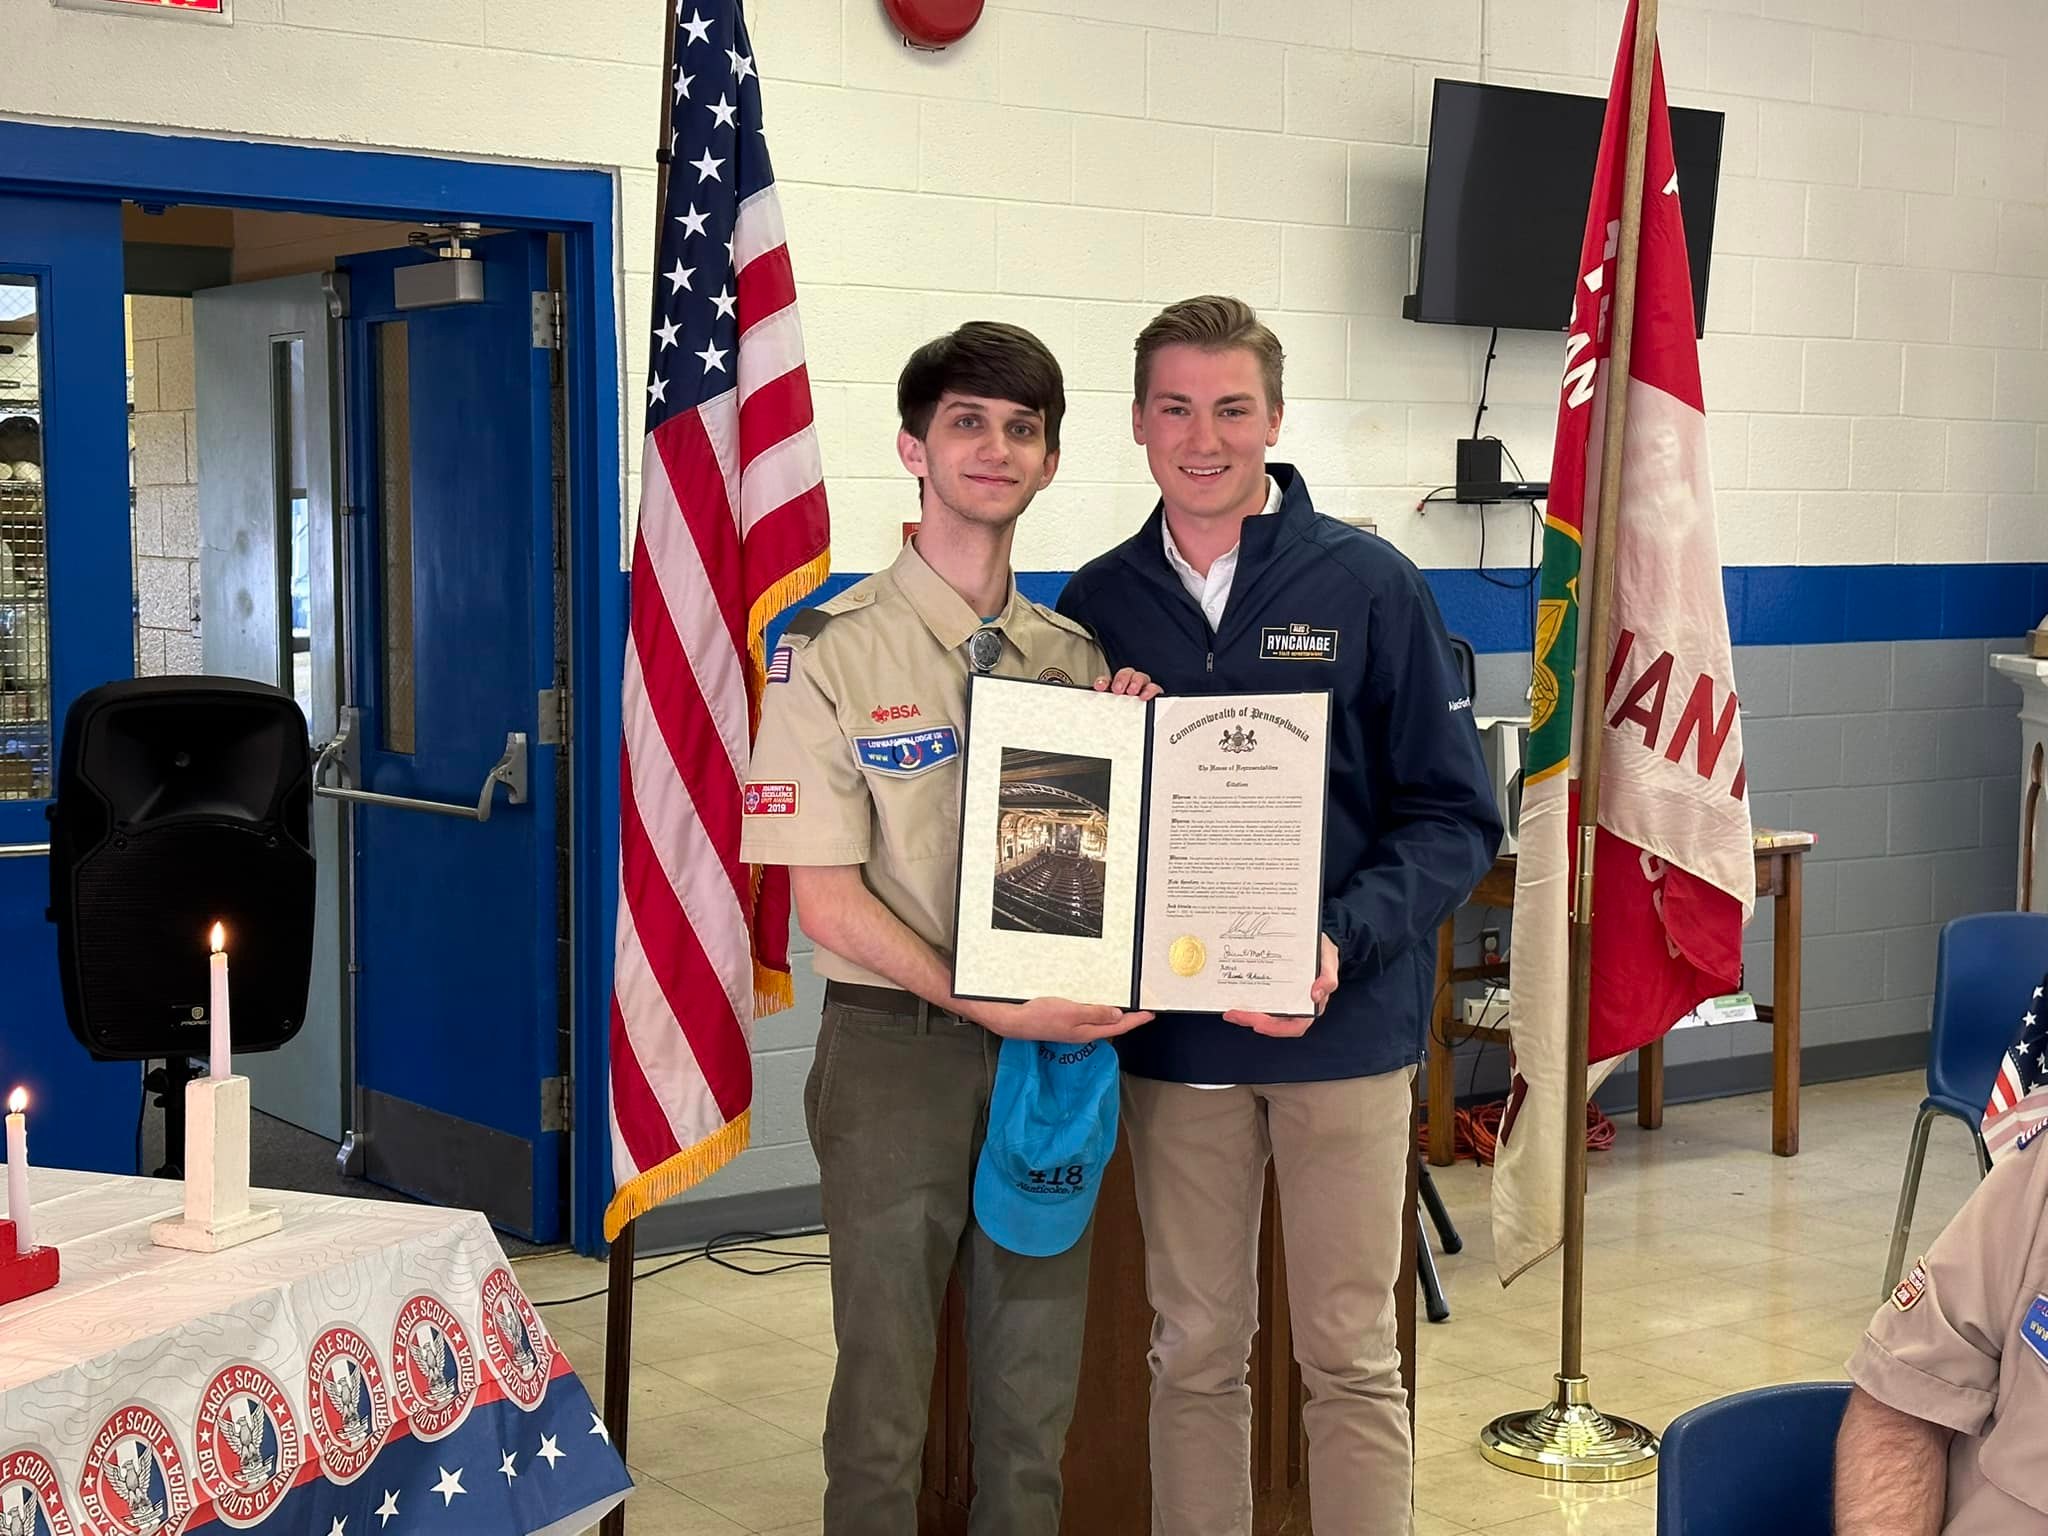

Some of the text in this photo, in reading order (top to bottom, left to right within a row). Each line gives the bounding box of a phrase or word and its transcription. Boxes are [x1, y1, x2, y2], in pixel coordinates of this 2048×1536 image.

[1267, 635, 1331, 651] RYNCAVAGE
[890, 704, 921, 719] BSA
[1169, 707, 1310, 745] Commonwealth of Pennsylvania
[767, 803, 786, 813] 2019
[1058, 1041, 1097, 1065] TROOP
[1028, 1165, 1083, 1186] 418
[396, 1300, 456, 1348] EAGLE SCOUT
[310, 1332, 372, 1383] EAGLE SCOUT
[486, 1334, 540, 1401] BOY SCOUTS OF
[201, 1370, 279, 1424] EAGLE SCOUT
[395, 1371, 413, 1401] BOY
[440, 1404, 453, 1426] OF
[455, 1345, 477, 1411] AMERICA
[88, 1411, 168, 1468] EAGLE SCOUT
[311, 1381, 392, 1473] BOY SCOUTS OF AMERICA
[14, 1455, 54, 1491] SCOUT
[199, 1447, 220, 1483] BOY
[215, 1481, 252, 1516] SCOUTS
[255, 1488, 271, 1510] OF
[273, 1419, 298, 1494] AMERICA
[83, 1494, 109, 1526] BOY
[164, 1462, 192, 1536] AMERICA
